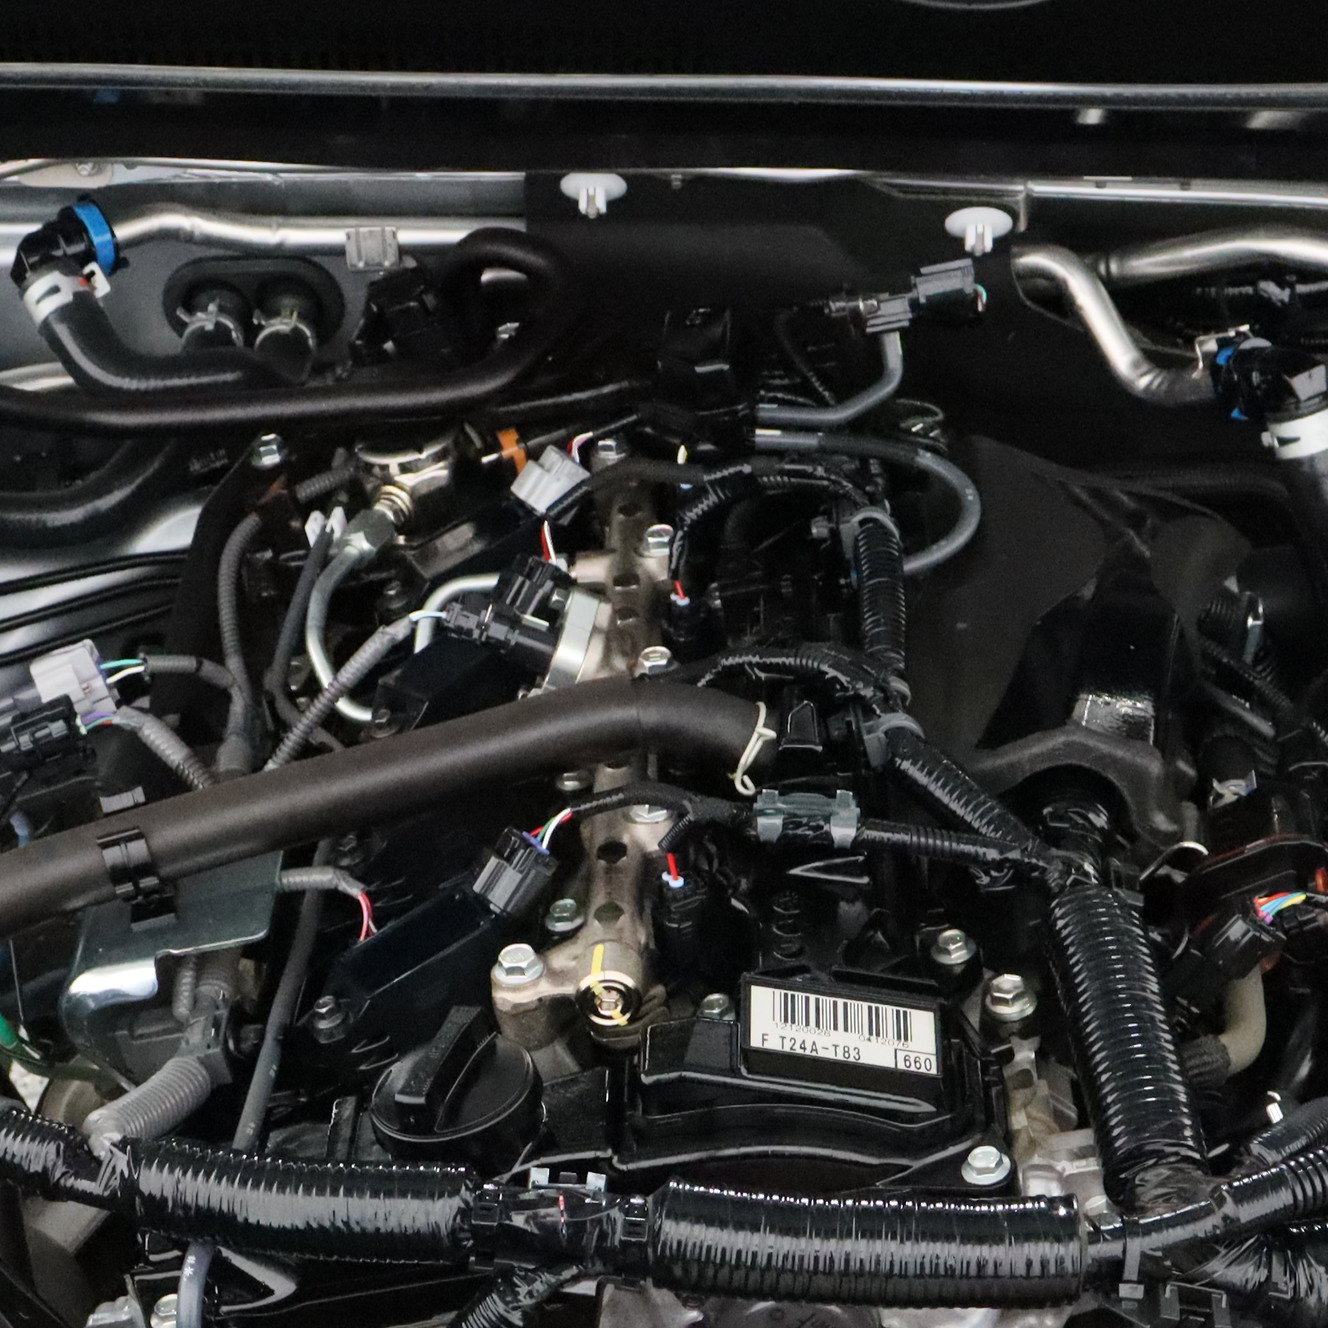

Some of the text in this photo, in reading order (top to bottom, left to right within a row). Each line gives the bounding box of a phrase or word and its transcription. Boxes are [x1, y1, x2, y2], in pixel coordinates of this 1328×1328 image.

[761, 1033, 862, 1062] F T24A-T83
[903, 1054, 933, 1072] 660
